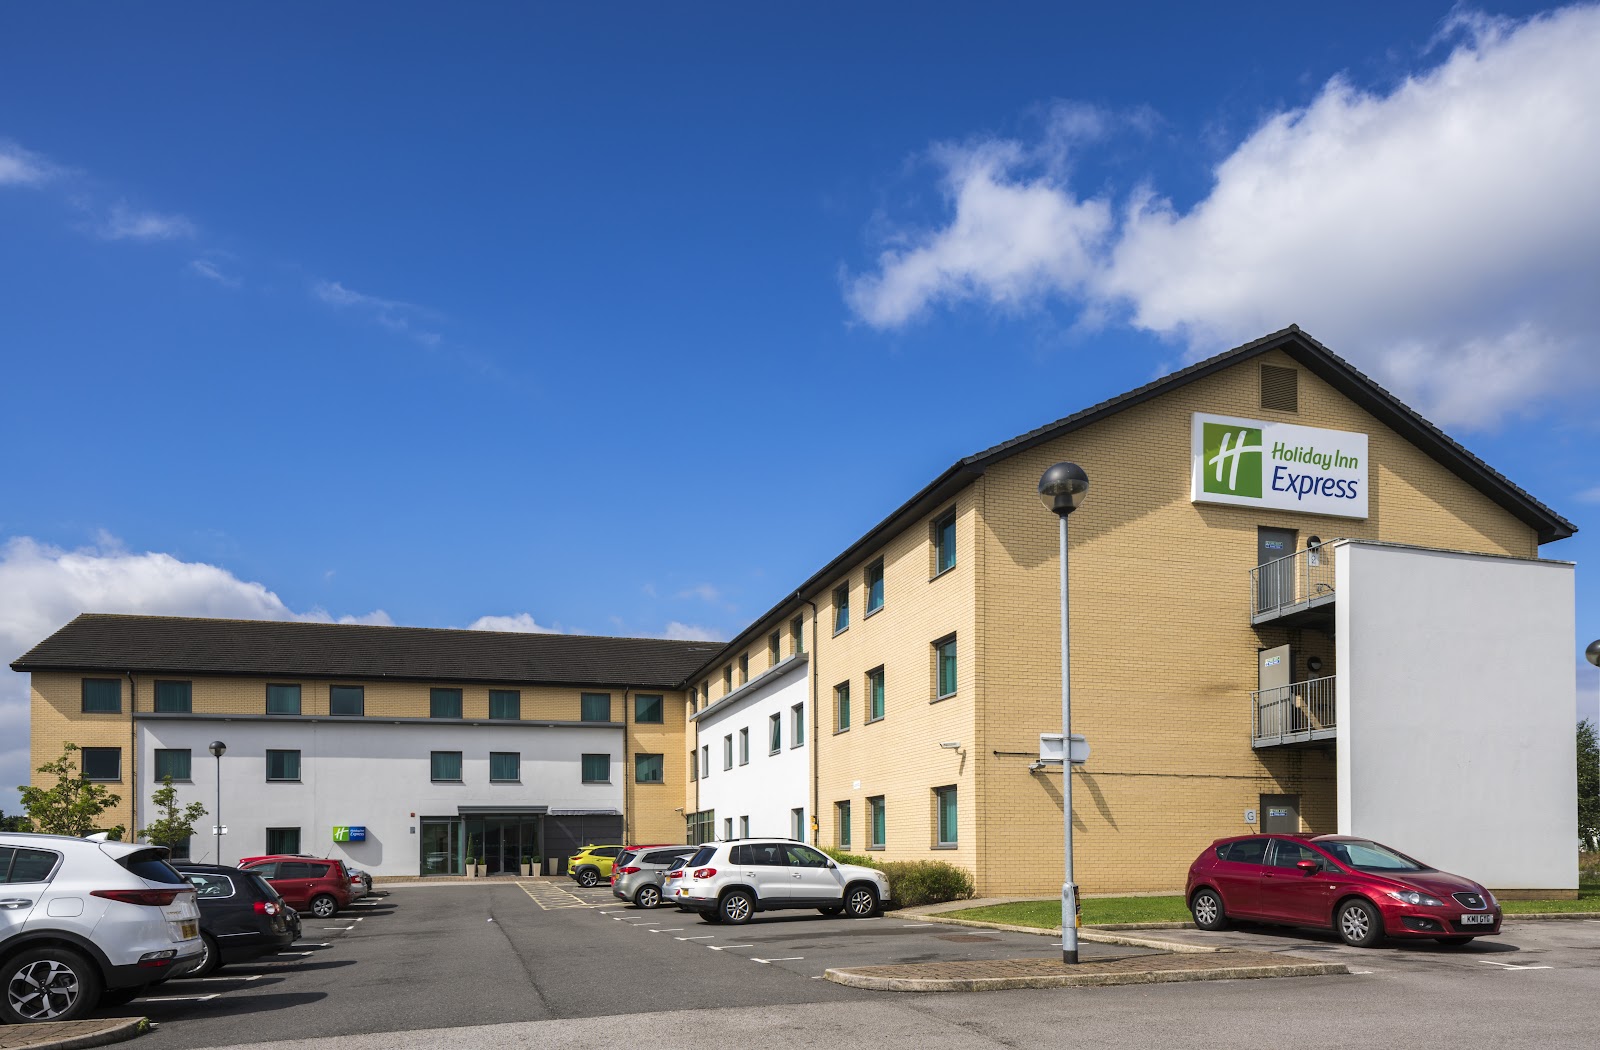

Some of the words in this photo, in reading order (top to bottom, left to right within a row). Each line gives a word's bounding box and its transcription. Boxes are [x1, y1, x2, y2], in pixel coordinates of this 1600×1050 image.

[1272, 441, 1332, 471] Holiday
[1334, 449, 1358, 469] Inn
[1271, 465, 1358, 501] Express
[1247, 812, 1254, 820] G
